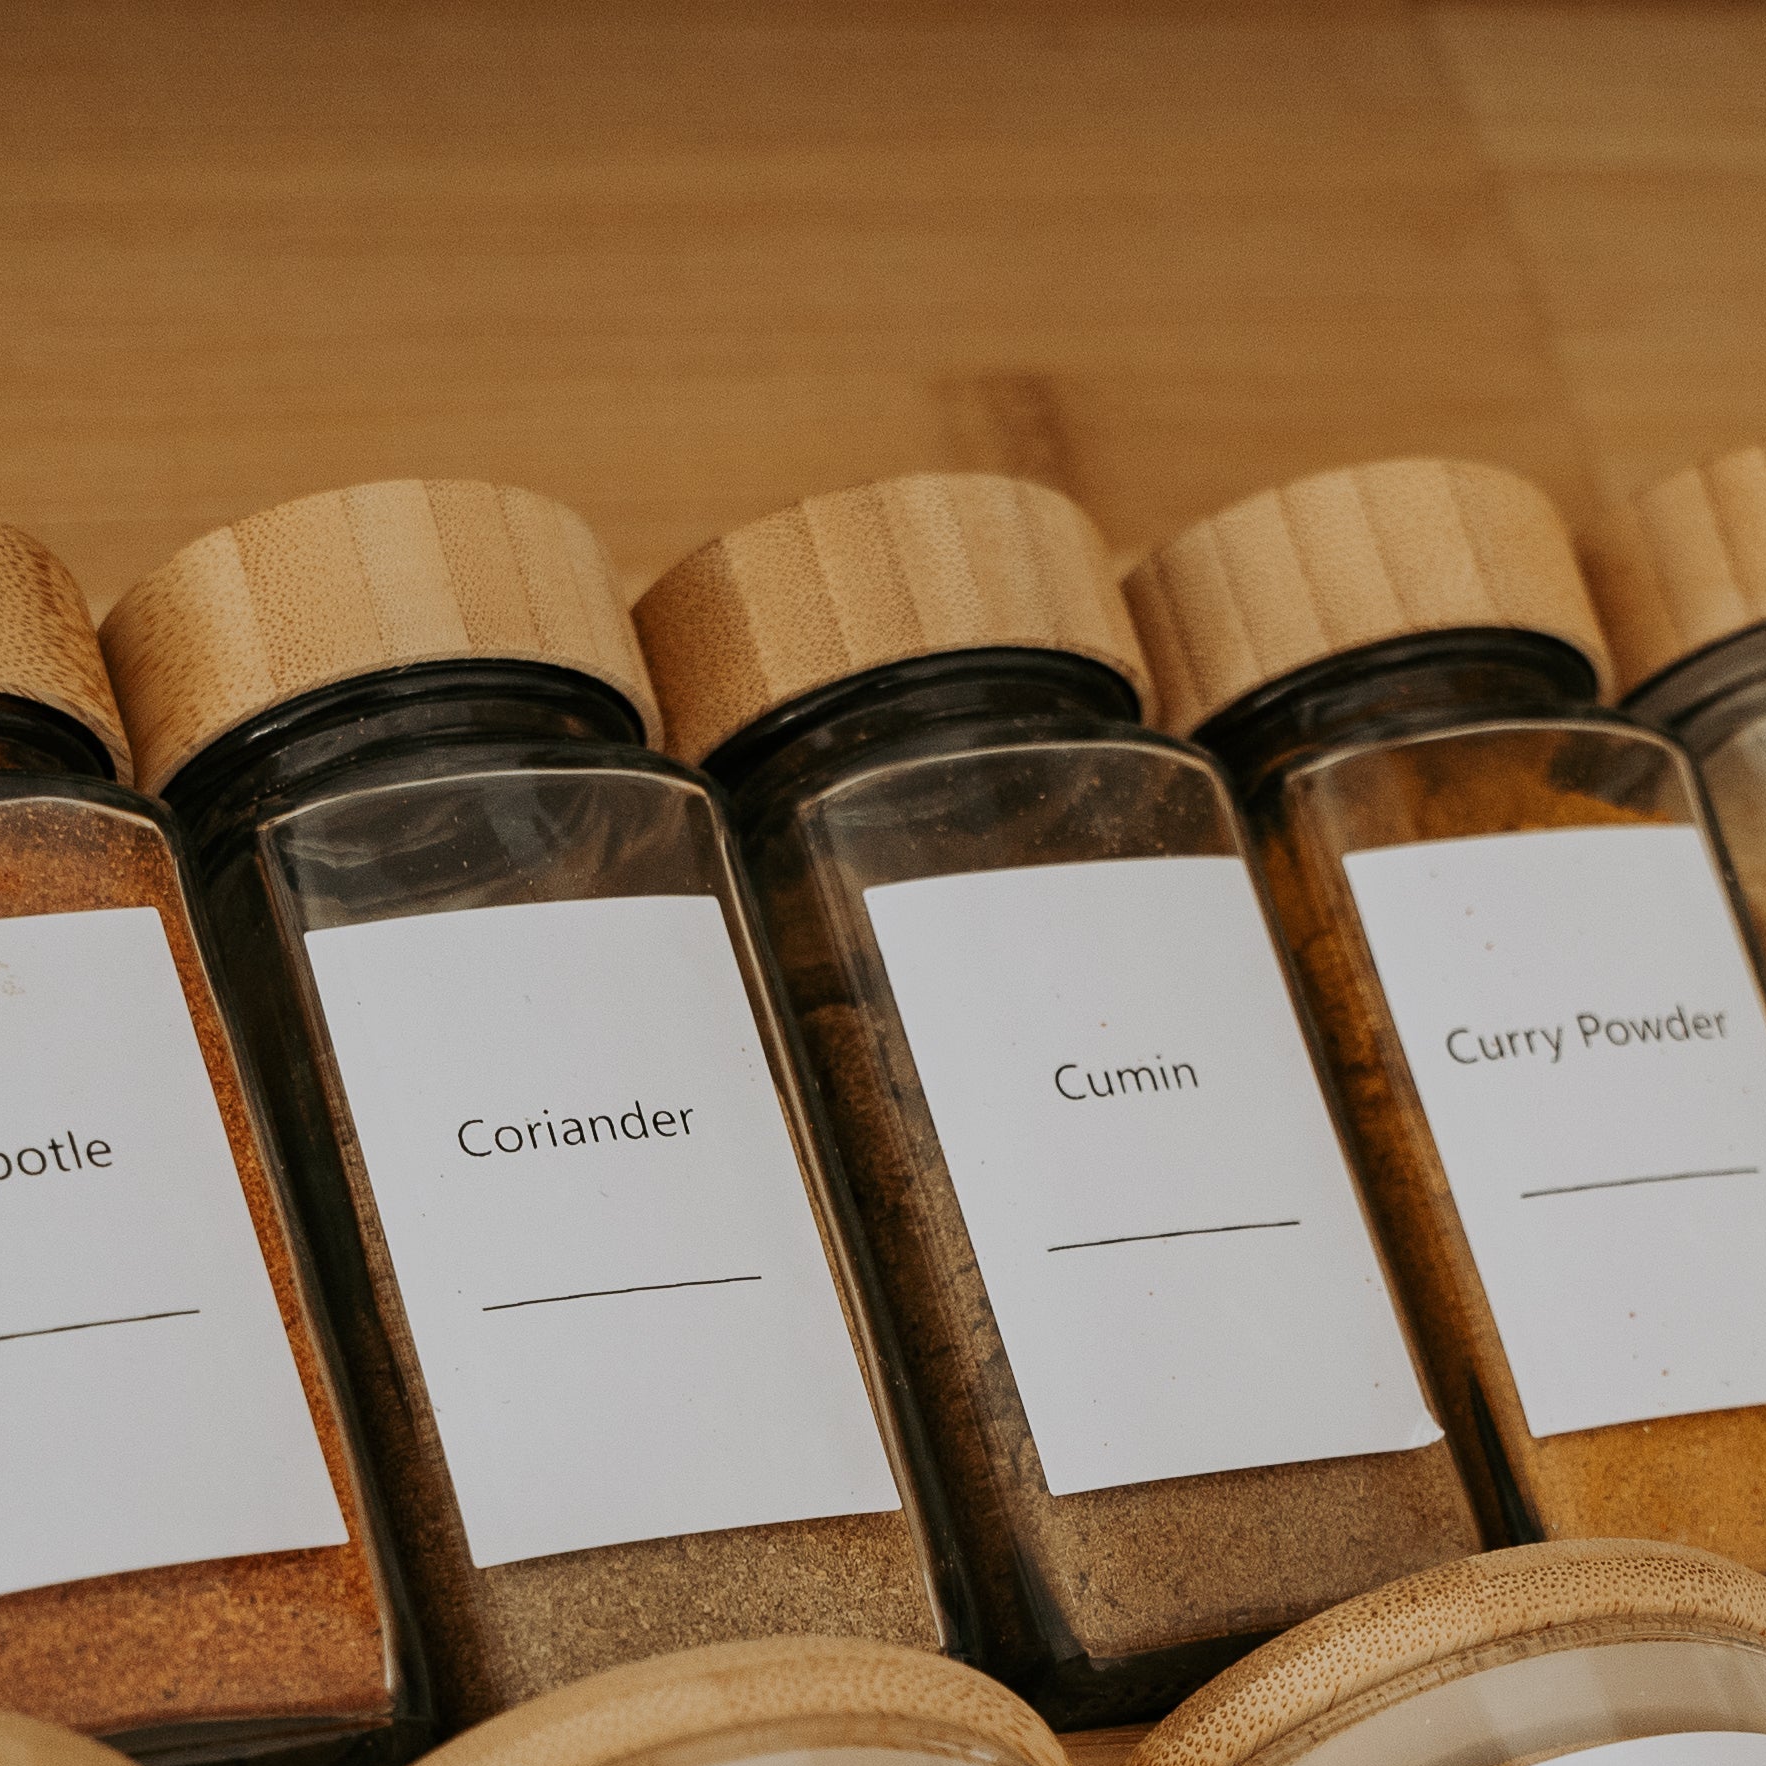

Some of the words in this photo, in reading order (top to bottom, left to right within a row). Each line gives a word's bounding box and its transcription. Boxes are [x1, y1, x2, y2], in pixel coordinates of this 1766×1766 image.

[1446, 1026, 1562, 1064] Curry
[1577, 1006, 1724, 1046] Powder
[1054, 1055, 1198, 1101] Cumin
[458, 1100, 693, 1157] Coriander
